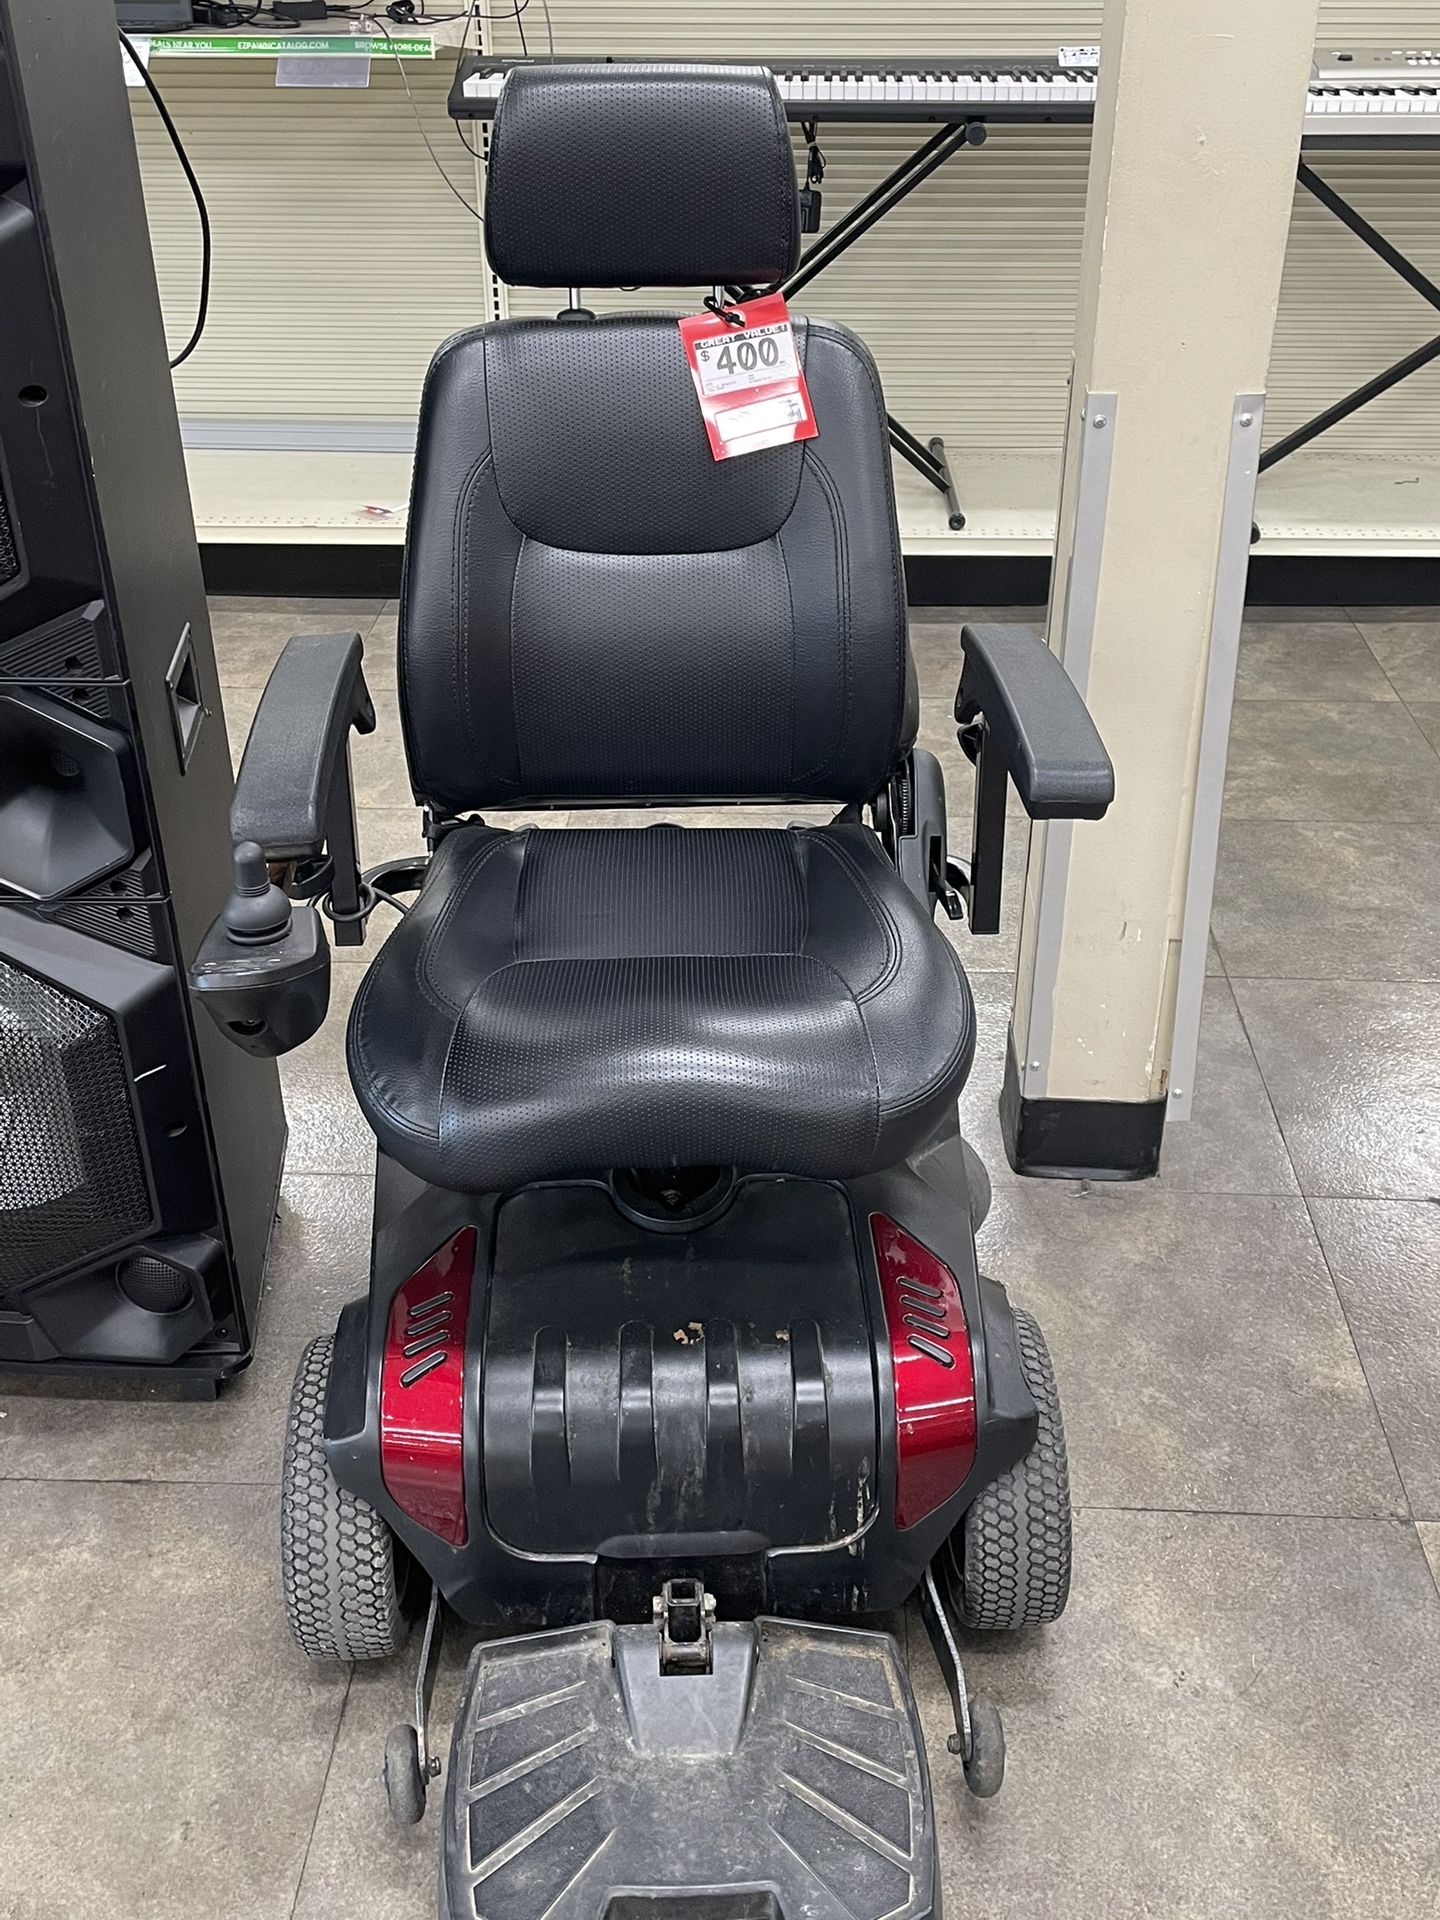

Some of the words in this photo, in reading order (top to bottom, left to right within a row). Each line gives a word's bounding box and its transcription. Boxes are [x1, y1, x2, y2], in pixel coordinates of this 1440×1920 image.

[194, 41, 213, 49] YOU
[355, 41, 388, 50] BROWSE
[701, 335, 736, 348] GREAT
